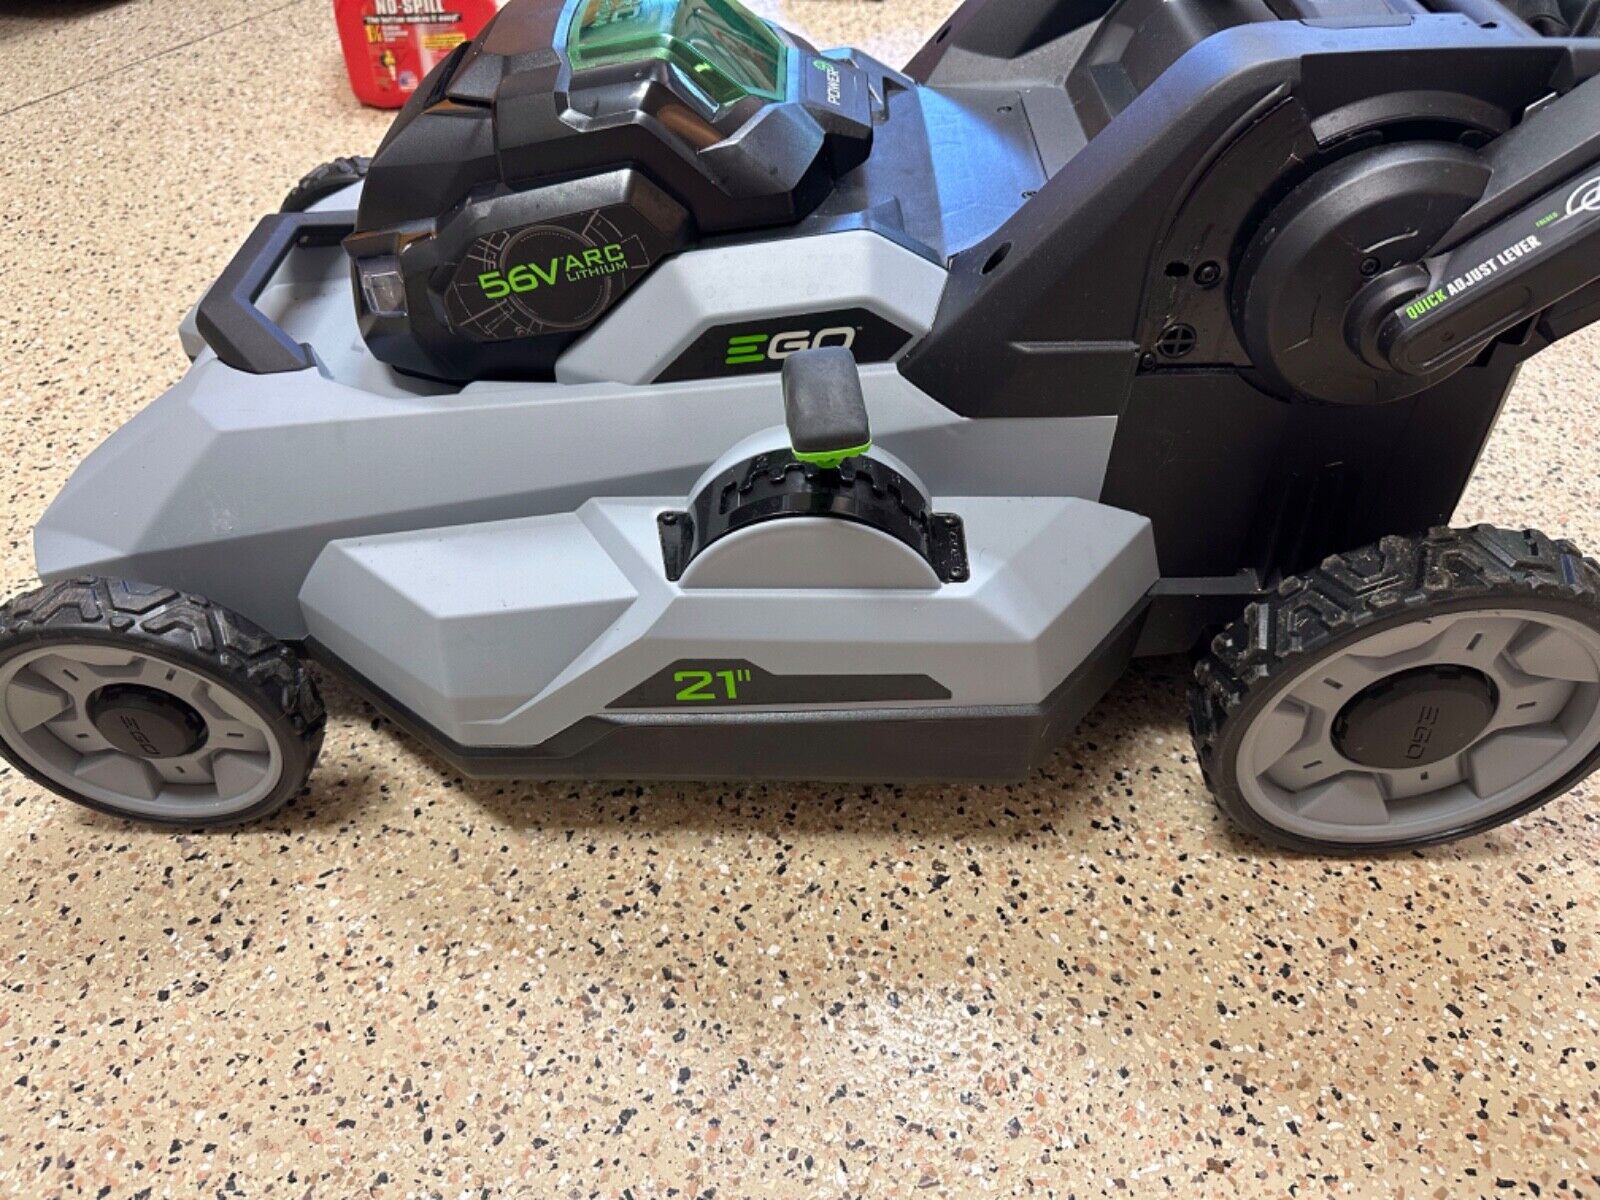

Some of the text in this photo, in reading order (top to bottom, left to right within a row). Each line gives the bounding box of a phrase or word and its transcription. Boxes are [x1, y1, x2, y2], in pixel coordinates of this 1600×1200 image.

[375, 0, 445, 14] NO-SPILL
[478, 243, 625, 299] 56V ARC
[566, 261, 628, 282] LITHIUM
[1406, 234, 1542, 320] QUICK ADJUST LEVER
[725, 326, 856, 364] EGO
[120, 715, 160, 755] EGO
[1405, 704, 1440, 760] EGO
